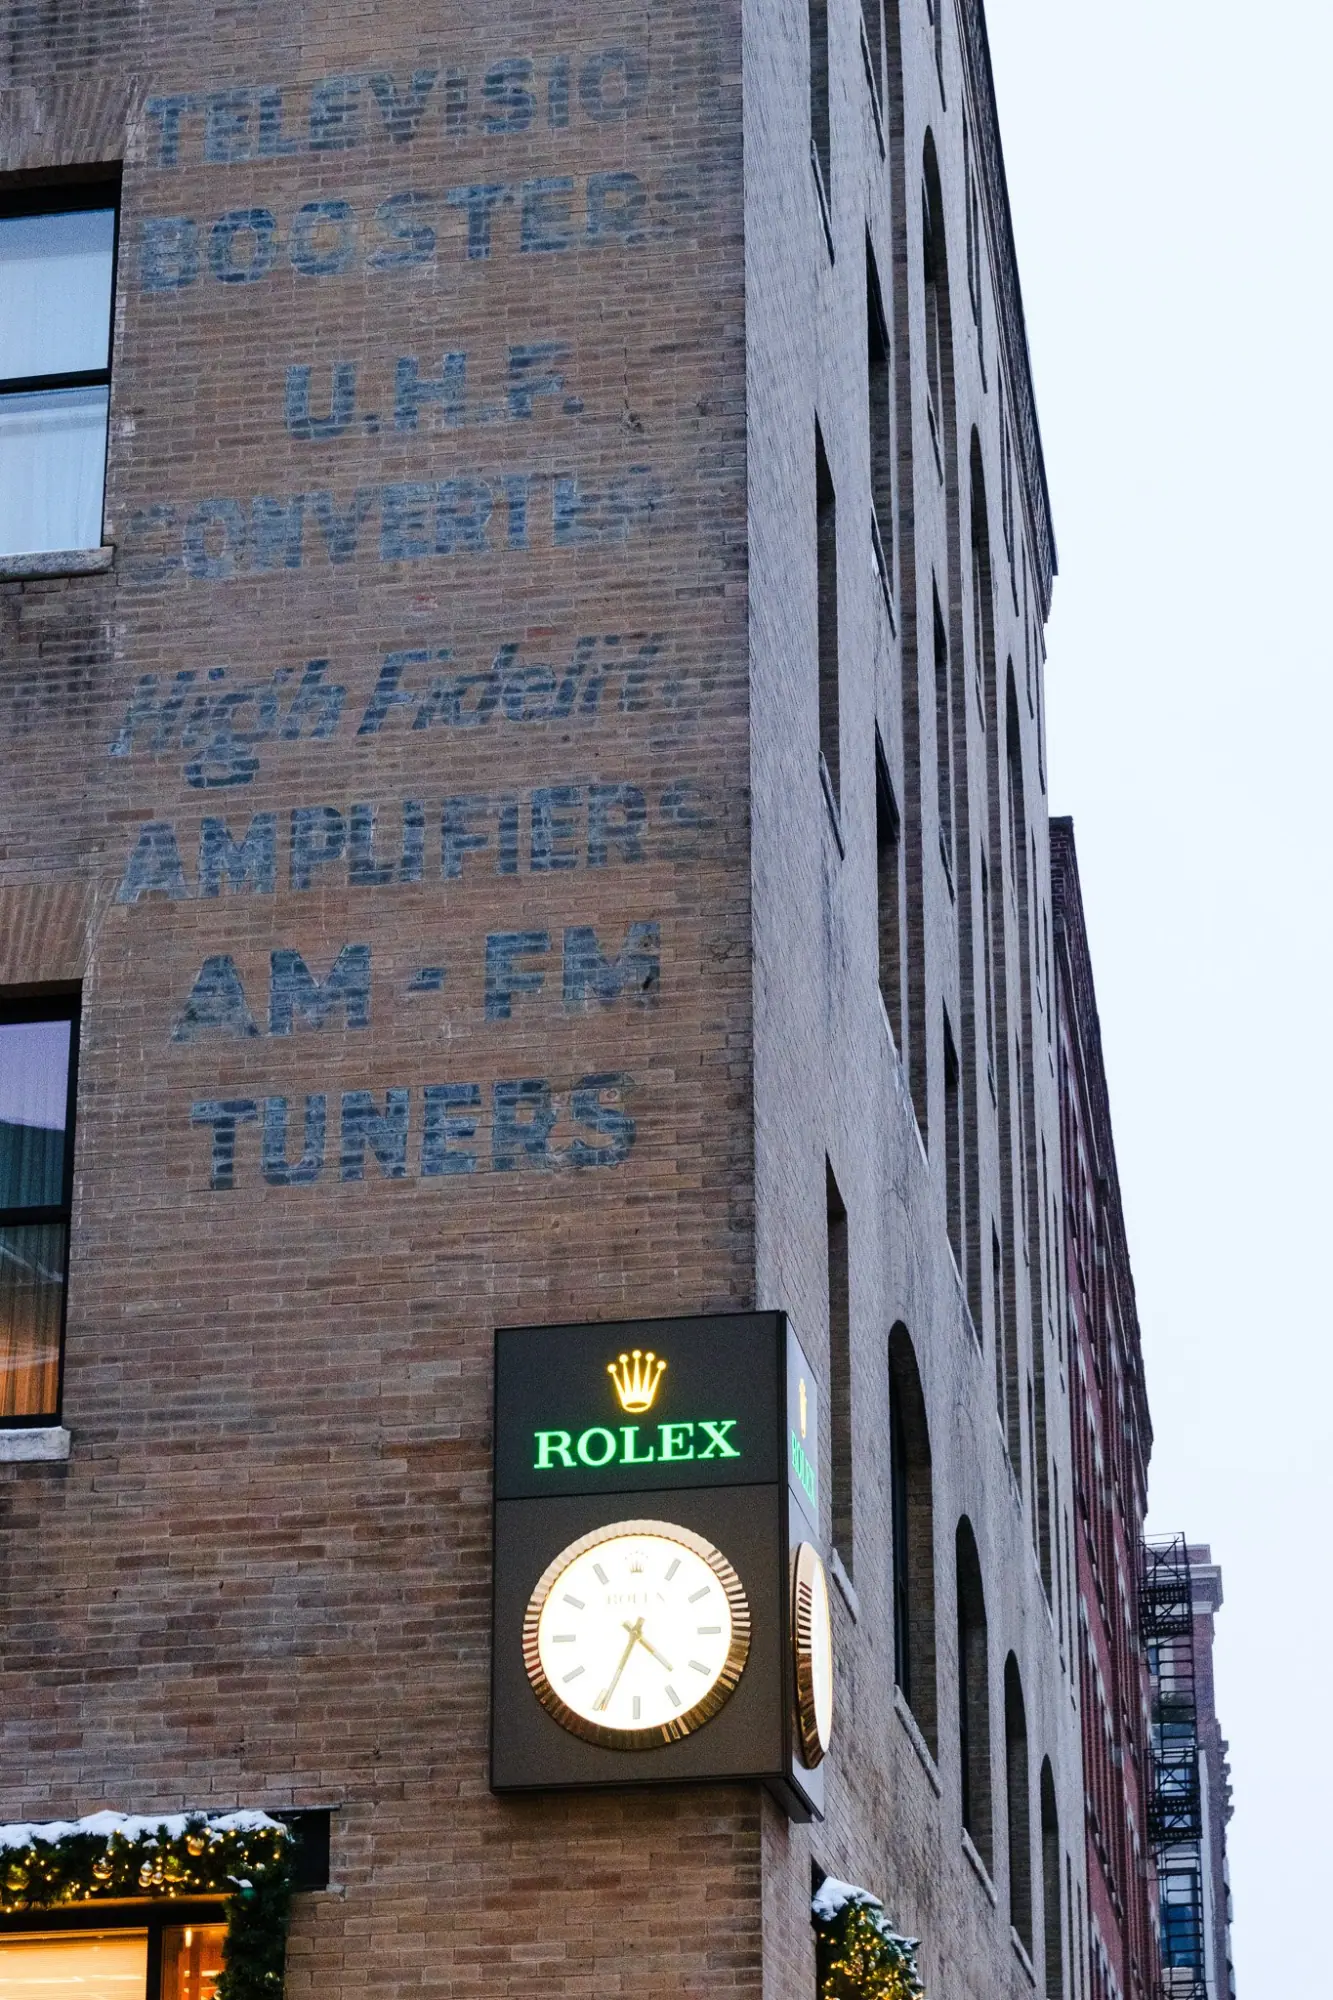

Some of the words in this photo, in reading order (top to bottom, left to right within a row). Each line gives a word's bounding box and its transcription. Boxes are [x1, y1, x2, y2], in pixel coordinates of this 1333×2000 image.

[107, 659, 346, 789] High
[116, 781, 712, 903] AMPLIFIERS
[170, 943, 373, 1043] AM
[483, 921, 662, 1022] FM
[190, 1071, 637, 1190] TUNERS
[532, 1419, 741, 1470] ROLEX
[791, 1428, 817, 1508] ROLEX
